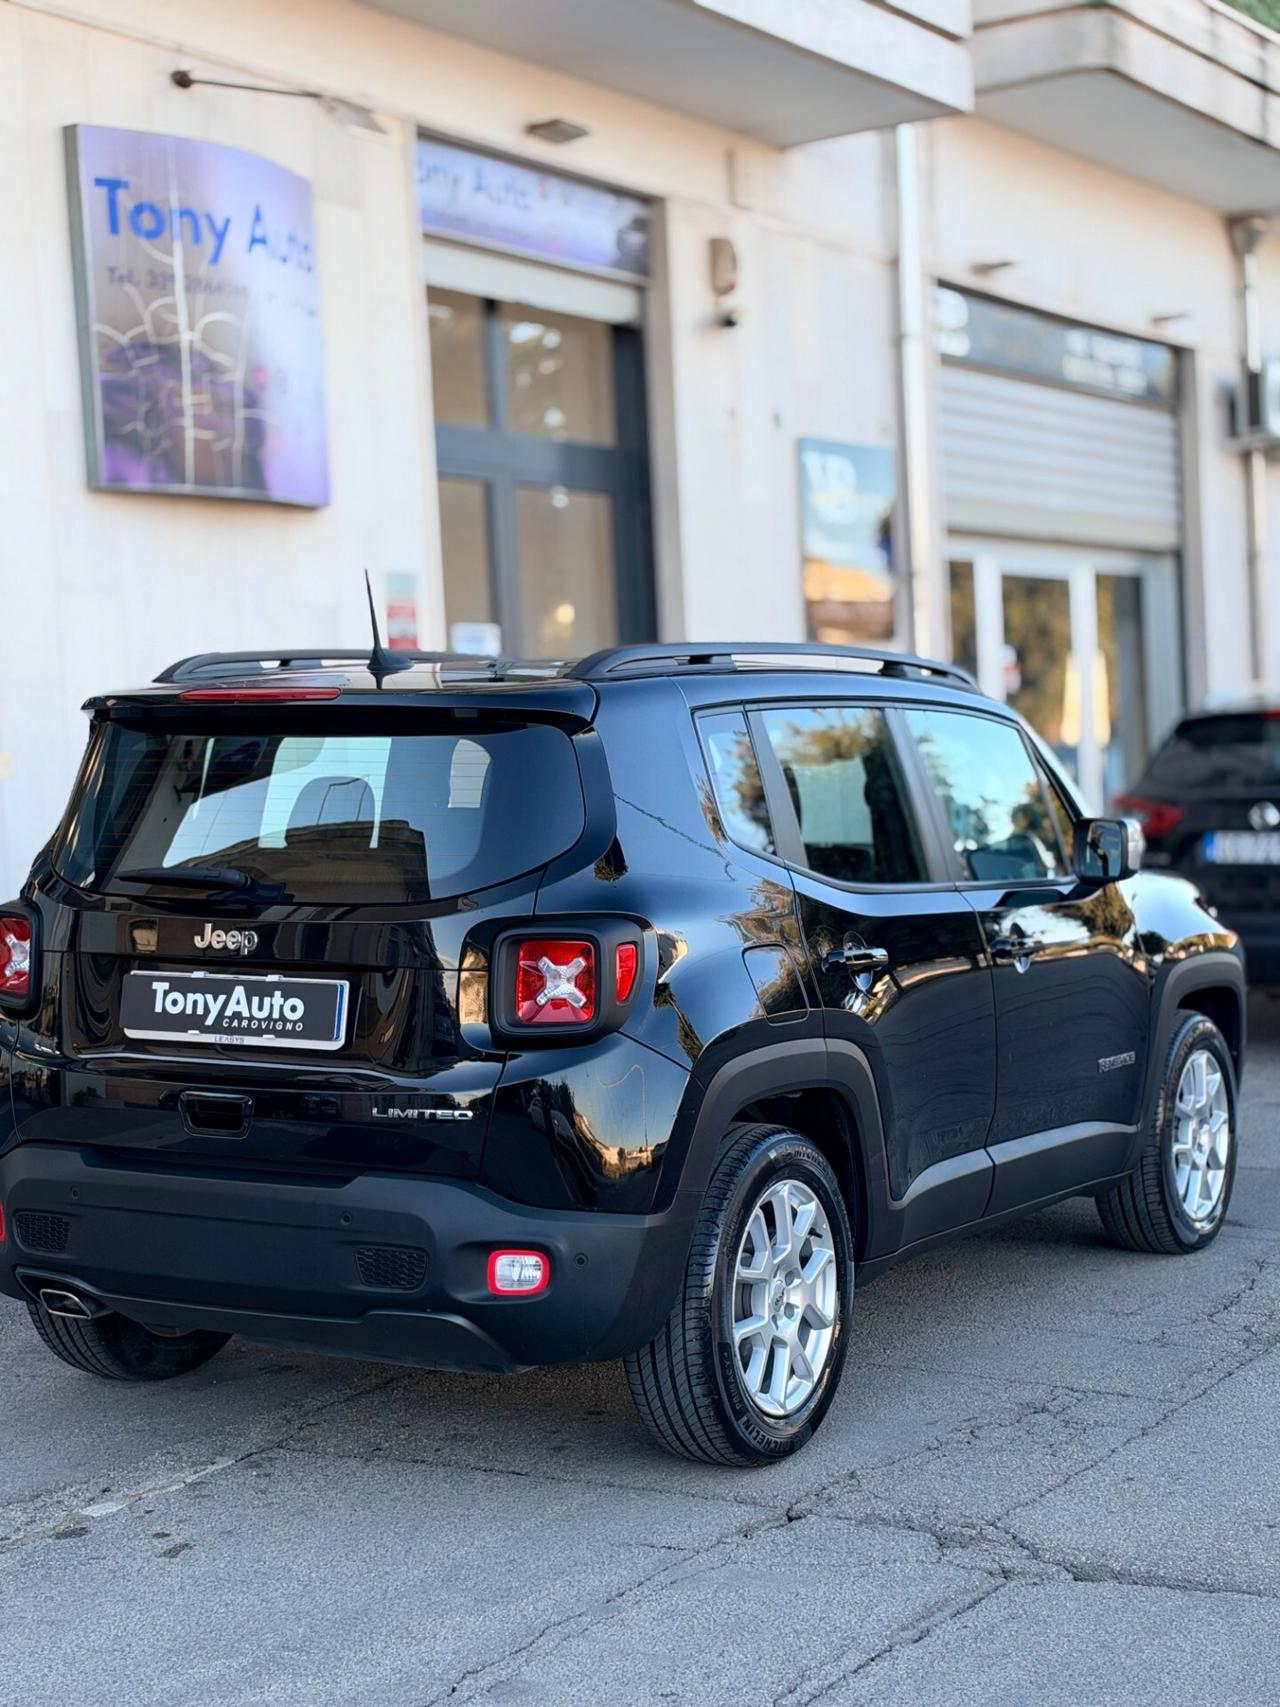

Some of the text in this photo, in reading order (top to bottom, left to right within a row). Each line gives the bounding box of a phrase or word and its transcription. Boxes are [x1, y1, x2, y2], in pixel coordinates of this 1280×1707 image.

[95, 178, 231, 266] Tony
[194, 923, 257, 955] Jeep
[152, 982, 304, 1025] TonyAuto
[222, 1019, 303, 1031] CAROVIGNO
[372, 1107, 473, 1120] LIMITED
